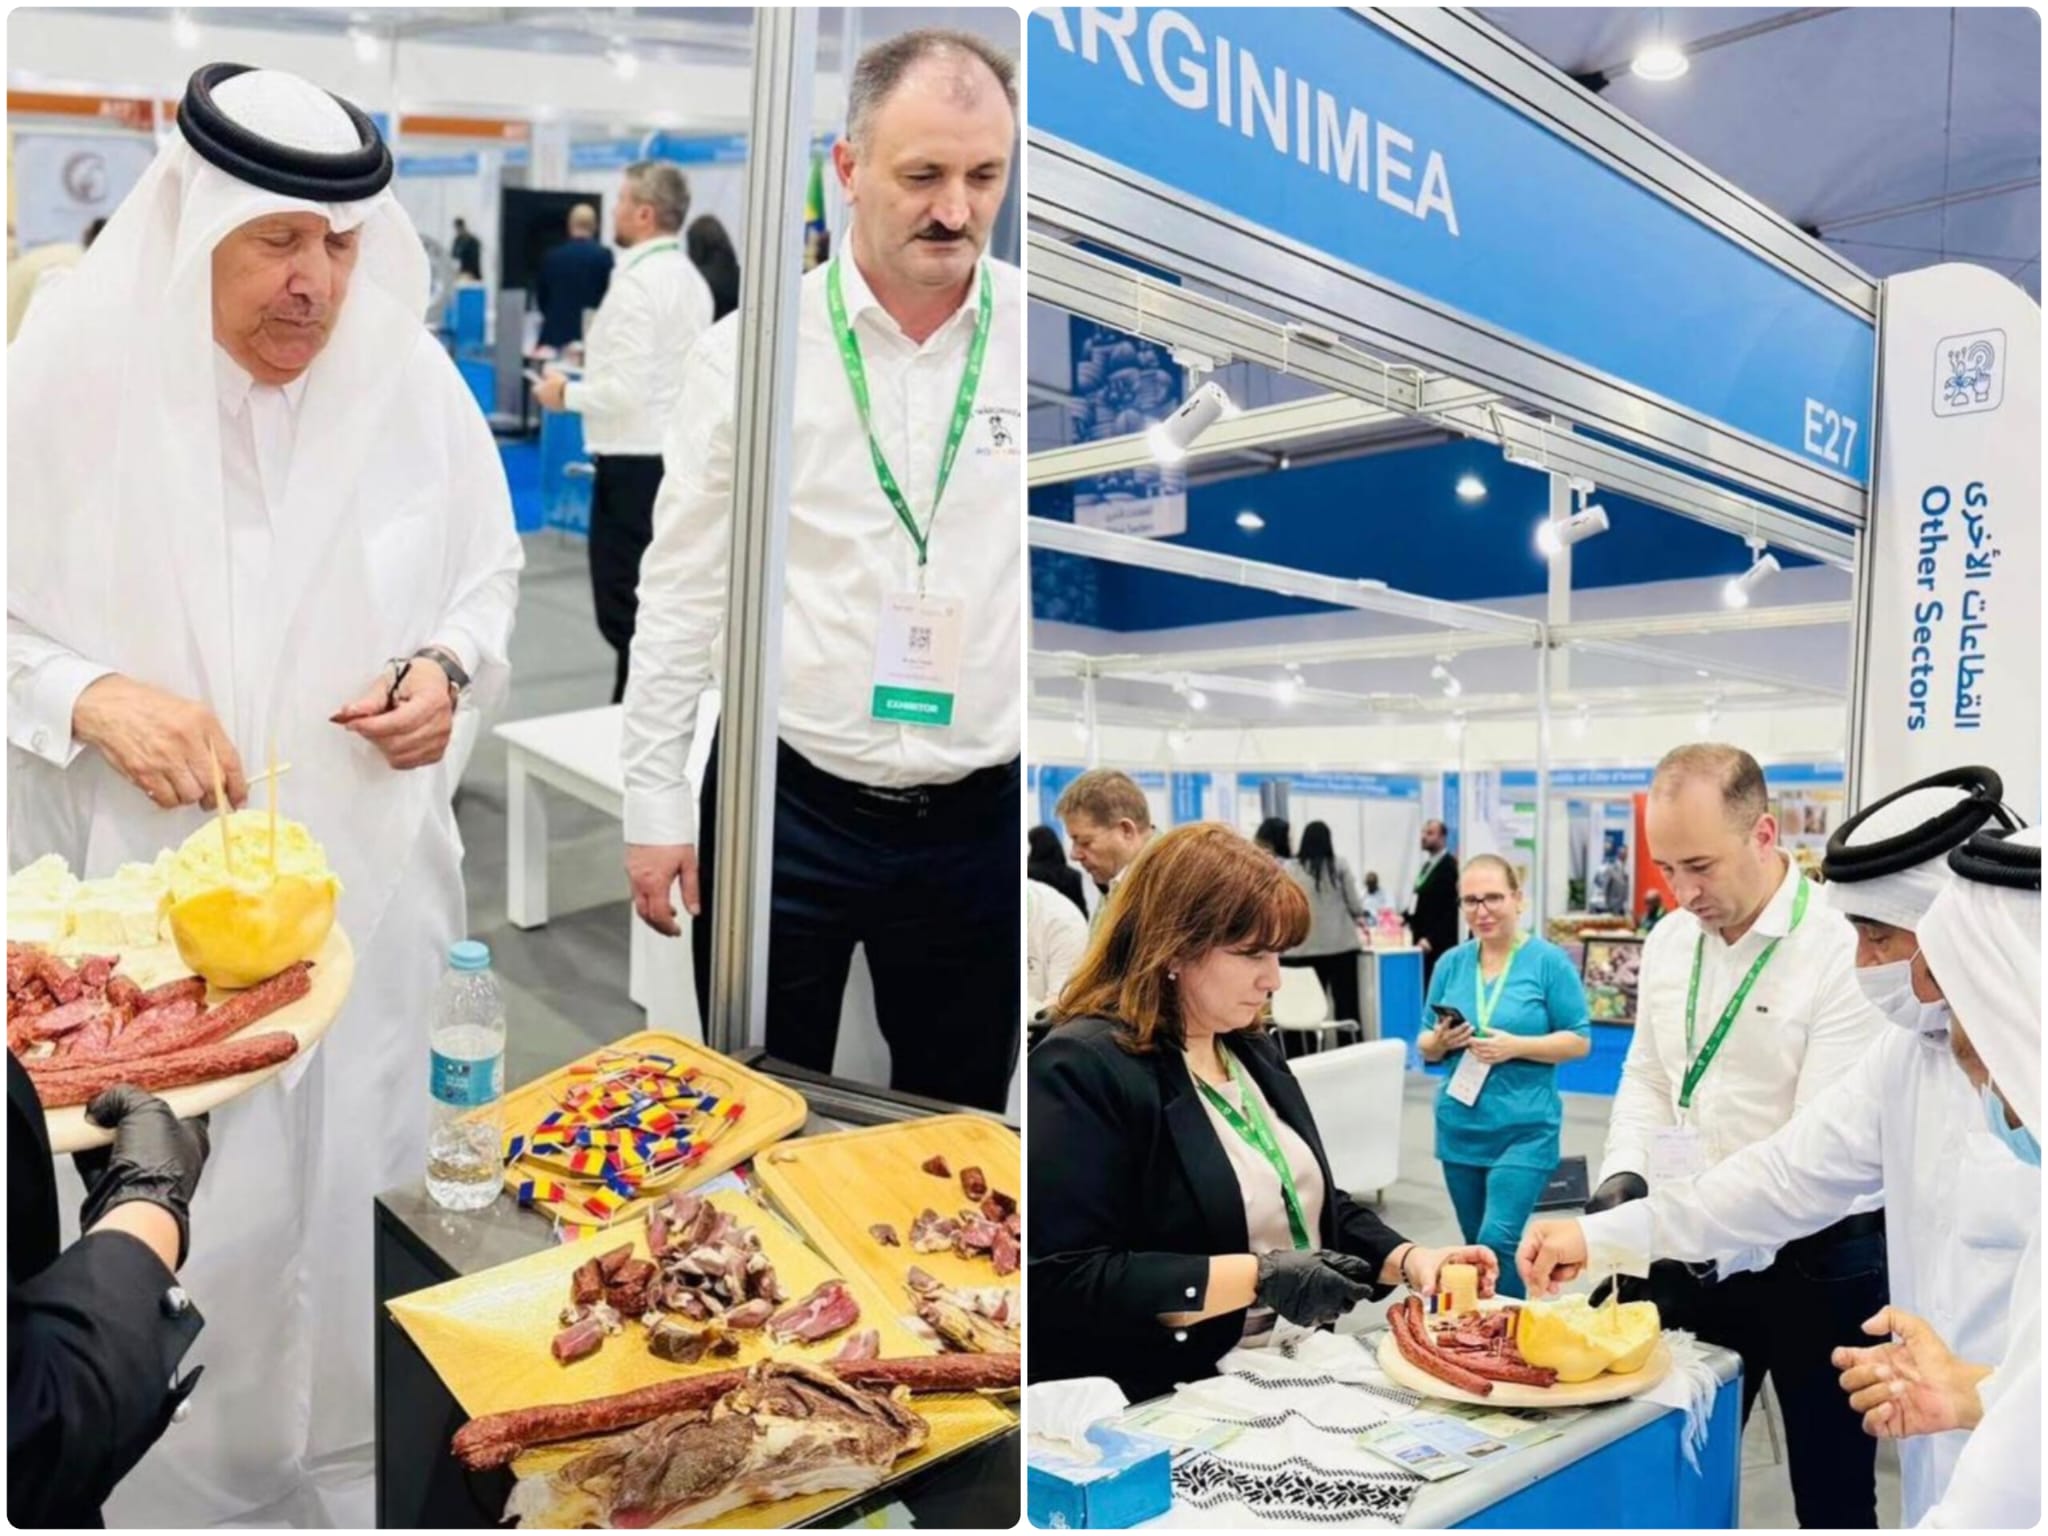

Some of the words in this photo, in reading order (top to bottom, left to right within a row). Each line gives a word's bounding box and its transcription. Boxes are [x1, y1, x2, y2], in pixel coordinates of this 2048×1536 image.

[1804, 397, 1858, 469] E27
[1917, 485, 1952, 591] Other
[1960, 481, 2001, 579] الأخرى
[1907, 600, 1944, 731] Sectors
[1954, 589, 1988, 729] القطاعات
